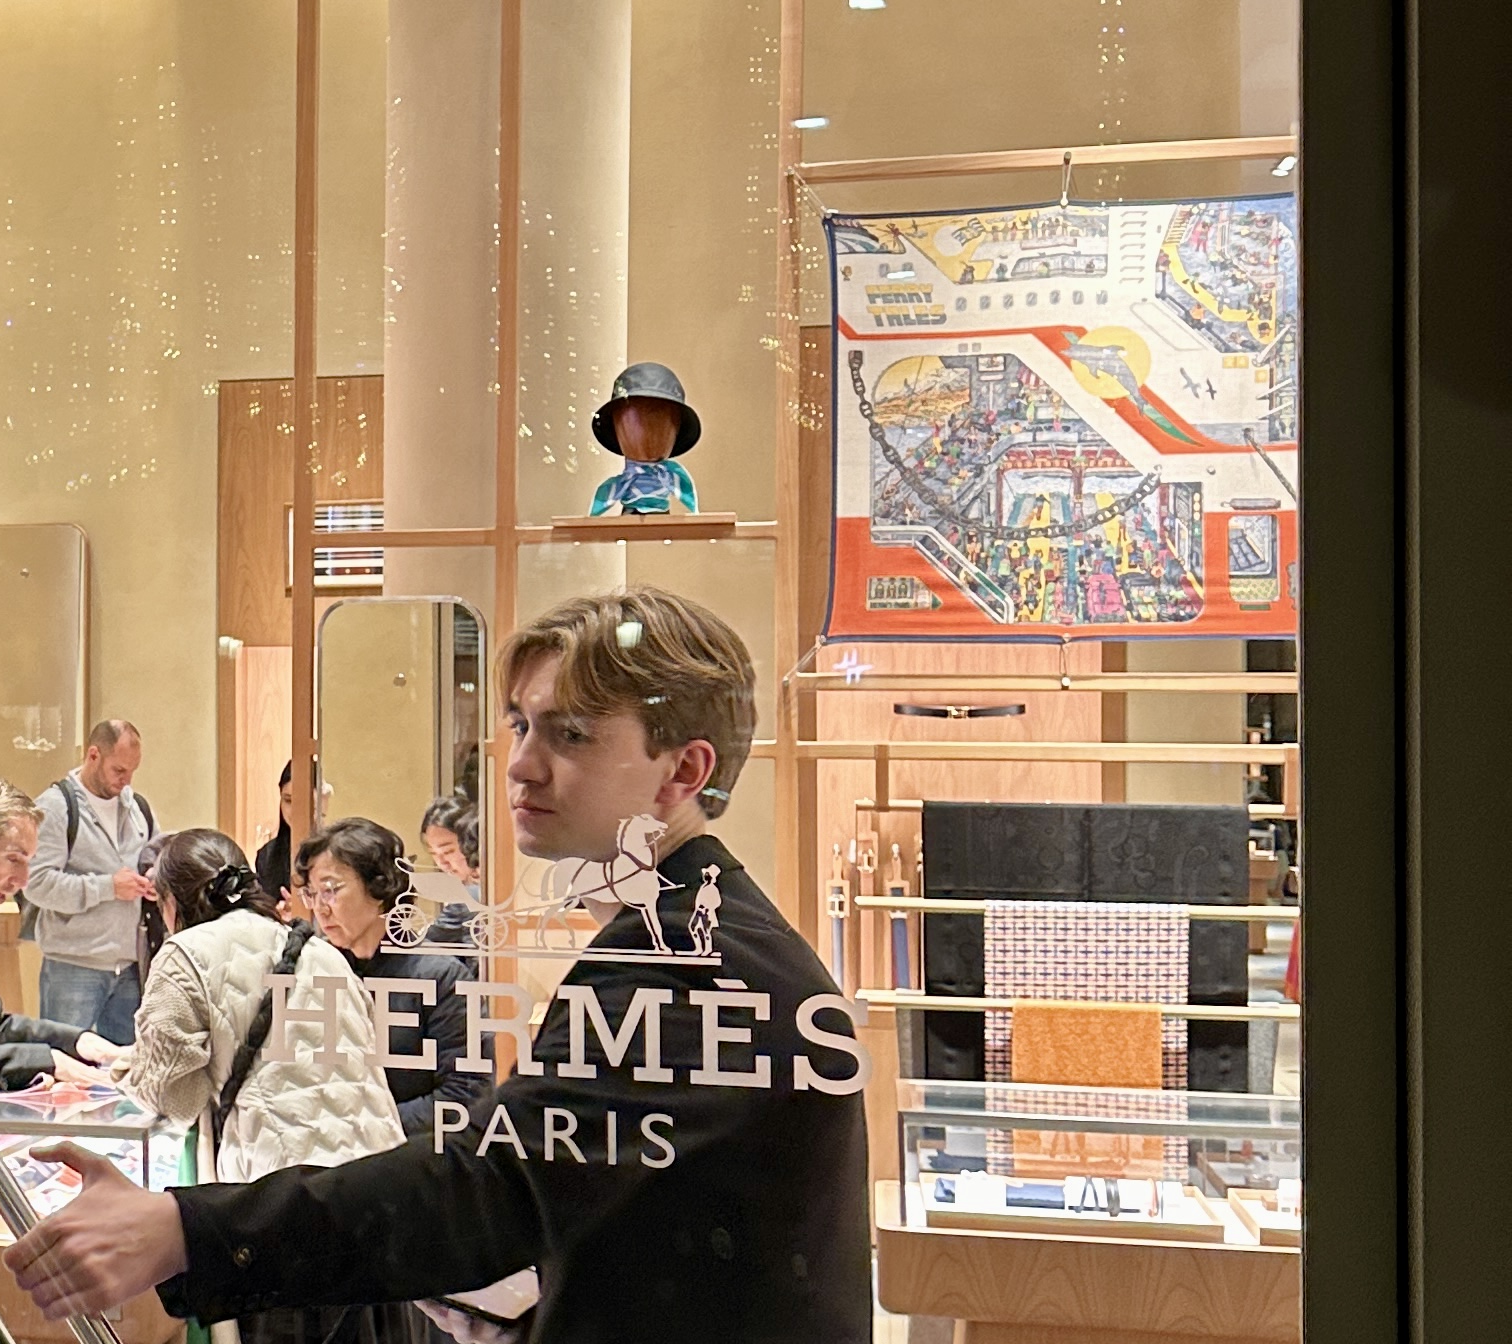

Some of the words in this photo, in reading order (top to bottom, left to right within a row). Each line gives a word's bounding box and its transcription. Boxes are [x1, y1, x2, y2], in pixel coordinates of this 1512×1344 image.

[865, 283, 934, 304] FERRY
[865, 304, 947, 327] TALES
[261, 973, 873, 1096] HERMÈS
[433, 1100, 676, 1169] PARIS
